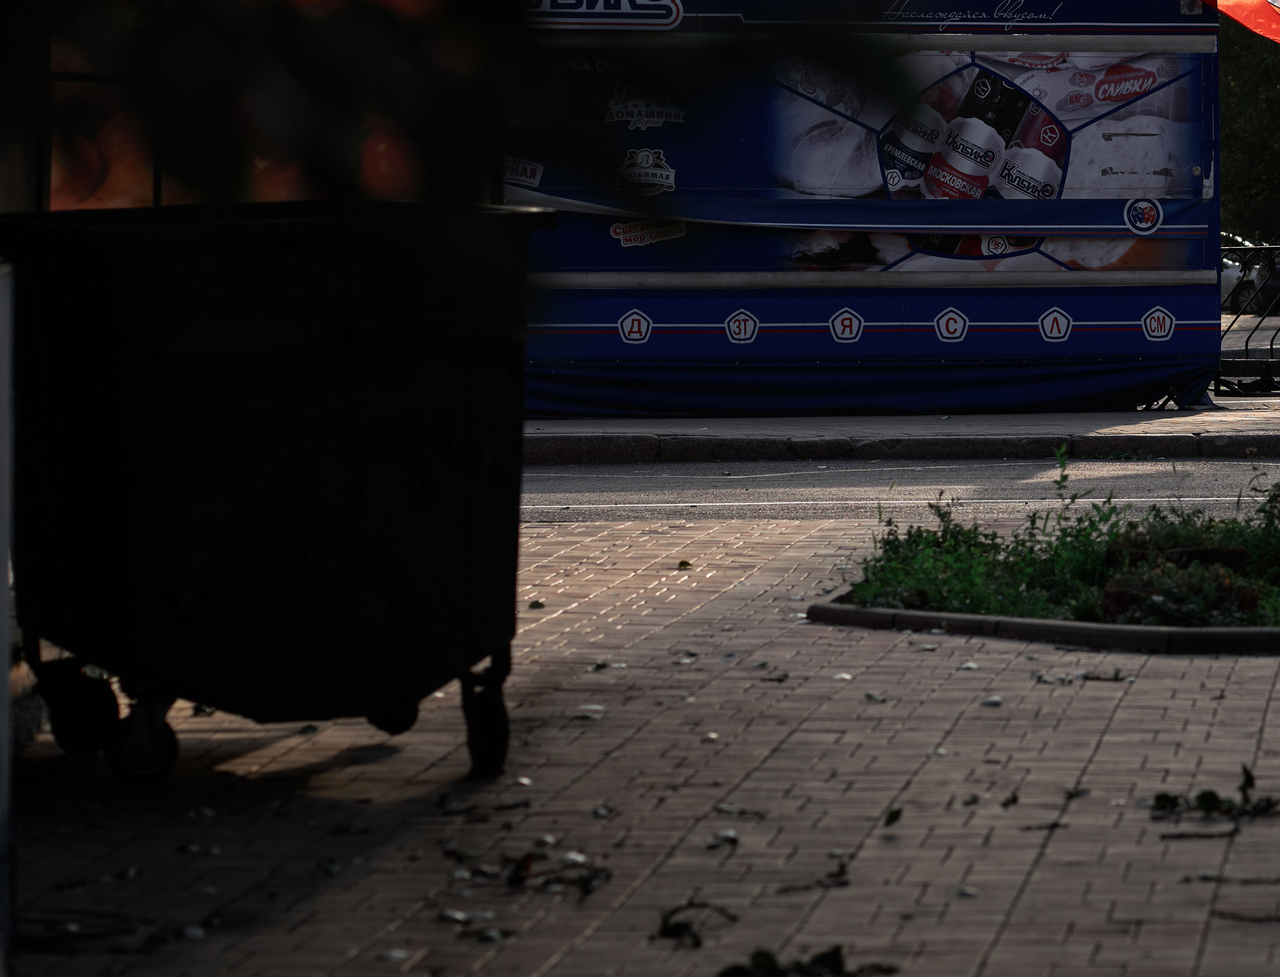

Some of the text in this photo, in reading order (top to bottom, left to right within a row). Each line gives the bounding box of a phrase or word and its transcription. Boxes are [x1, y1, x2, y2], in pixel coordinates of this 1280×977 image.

[1097, 77, 1154, 99] СЛИВКИ
[883, 143, 926, 172] КРЕМЛЕВСКАЯ
[927, 165, 982, 199] МОСКОВСКАЯ
[627, 319, 643, 337] Д
[840, 319, 853, 335] Я
[945, 318, 957, 335] С
[1149, 316, 1166, 333] СМ
